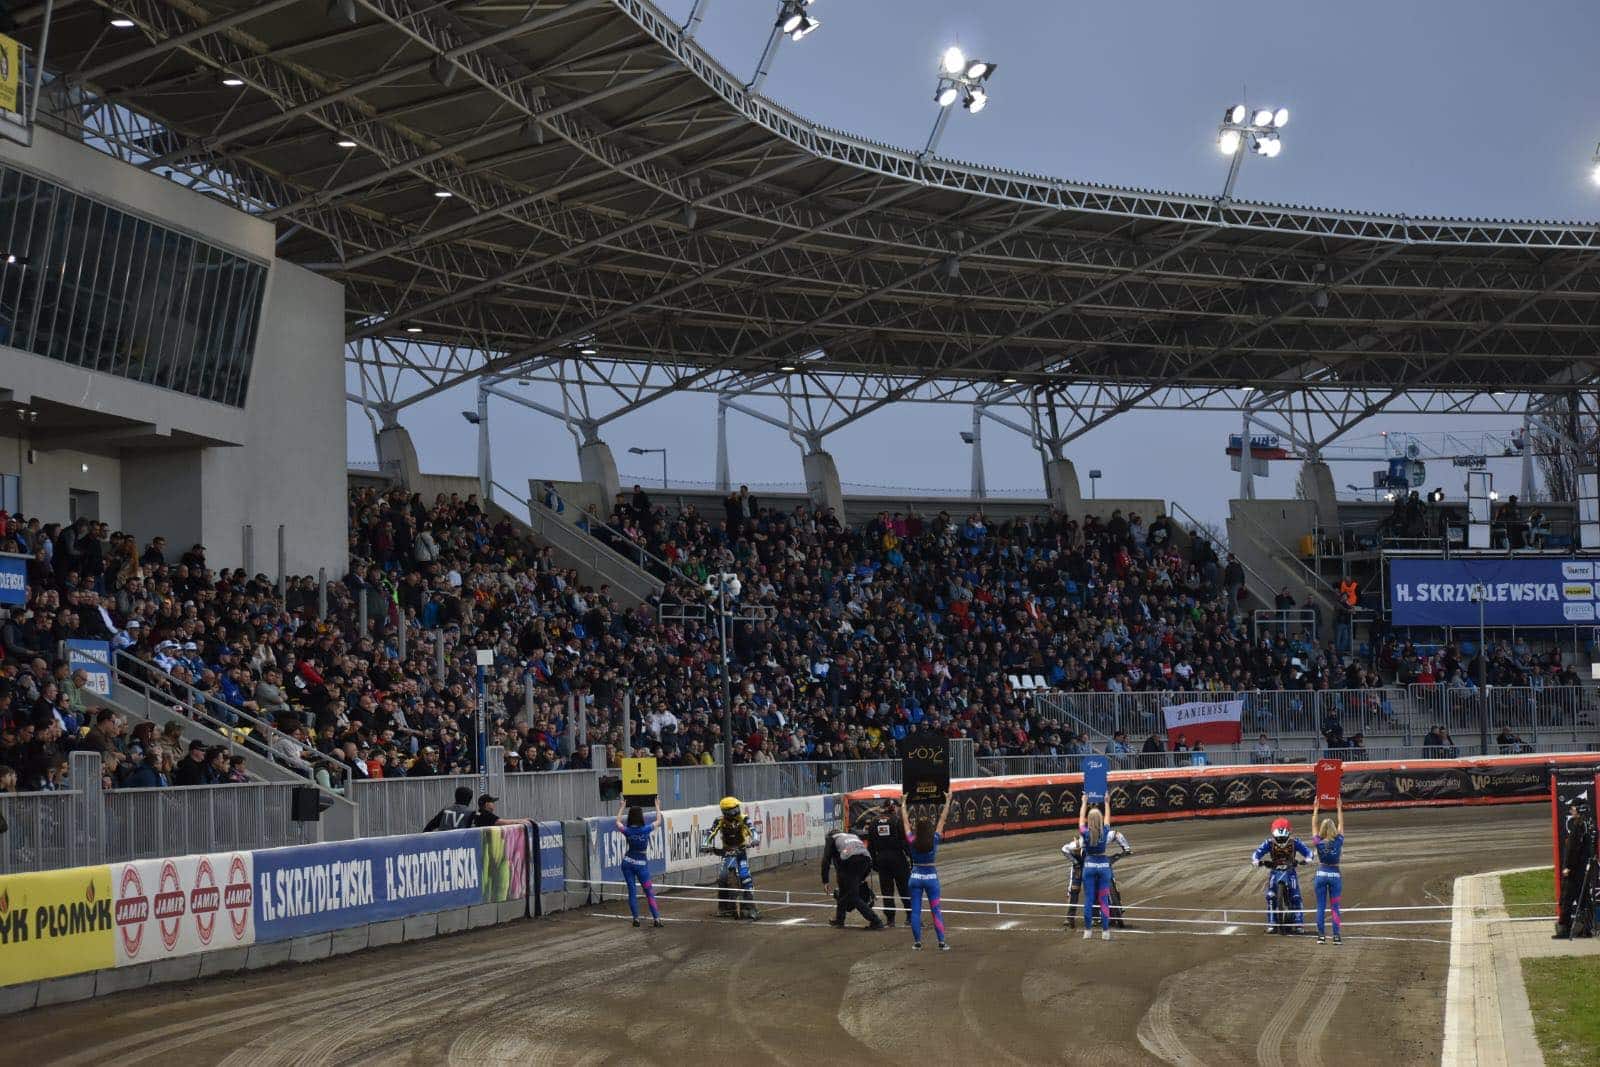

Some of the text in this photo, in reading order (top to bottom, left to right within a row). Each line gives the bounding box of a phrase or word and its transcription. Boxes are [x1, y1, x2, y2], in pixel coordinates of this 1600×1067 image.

[1396, 583, 1413, 602] H.
[1416, 582, 1560, 602] SKRZYDLEWSKA
[1262, 789, 1279, 800] PGE
[1295, 788, 1312, 800] PGE
[444, 810, 465, 827] TV
[385, 847, 478, 901] H. SKRZYDLEWSKA
[226, 888, 251, 906] JAMIR
[261, 859, 374, 921] H. SKRZYDLEWSKA
[117, 902, 147, 921] JAMIR
[156, 896, 184, 915] JAMIR
[192, 892, 218, 912] JAMIR
